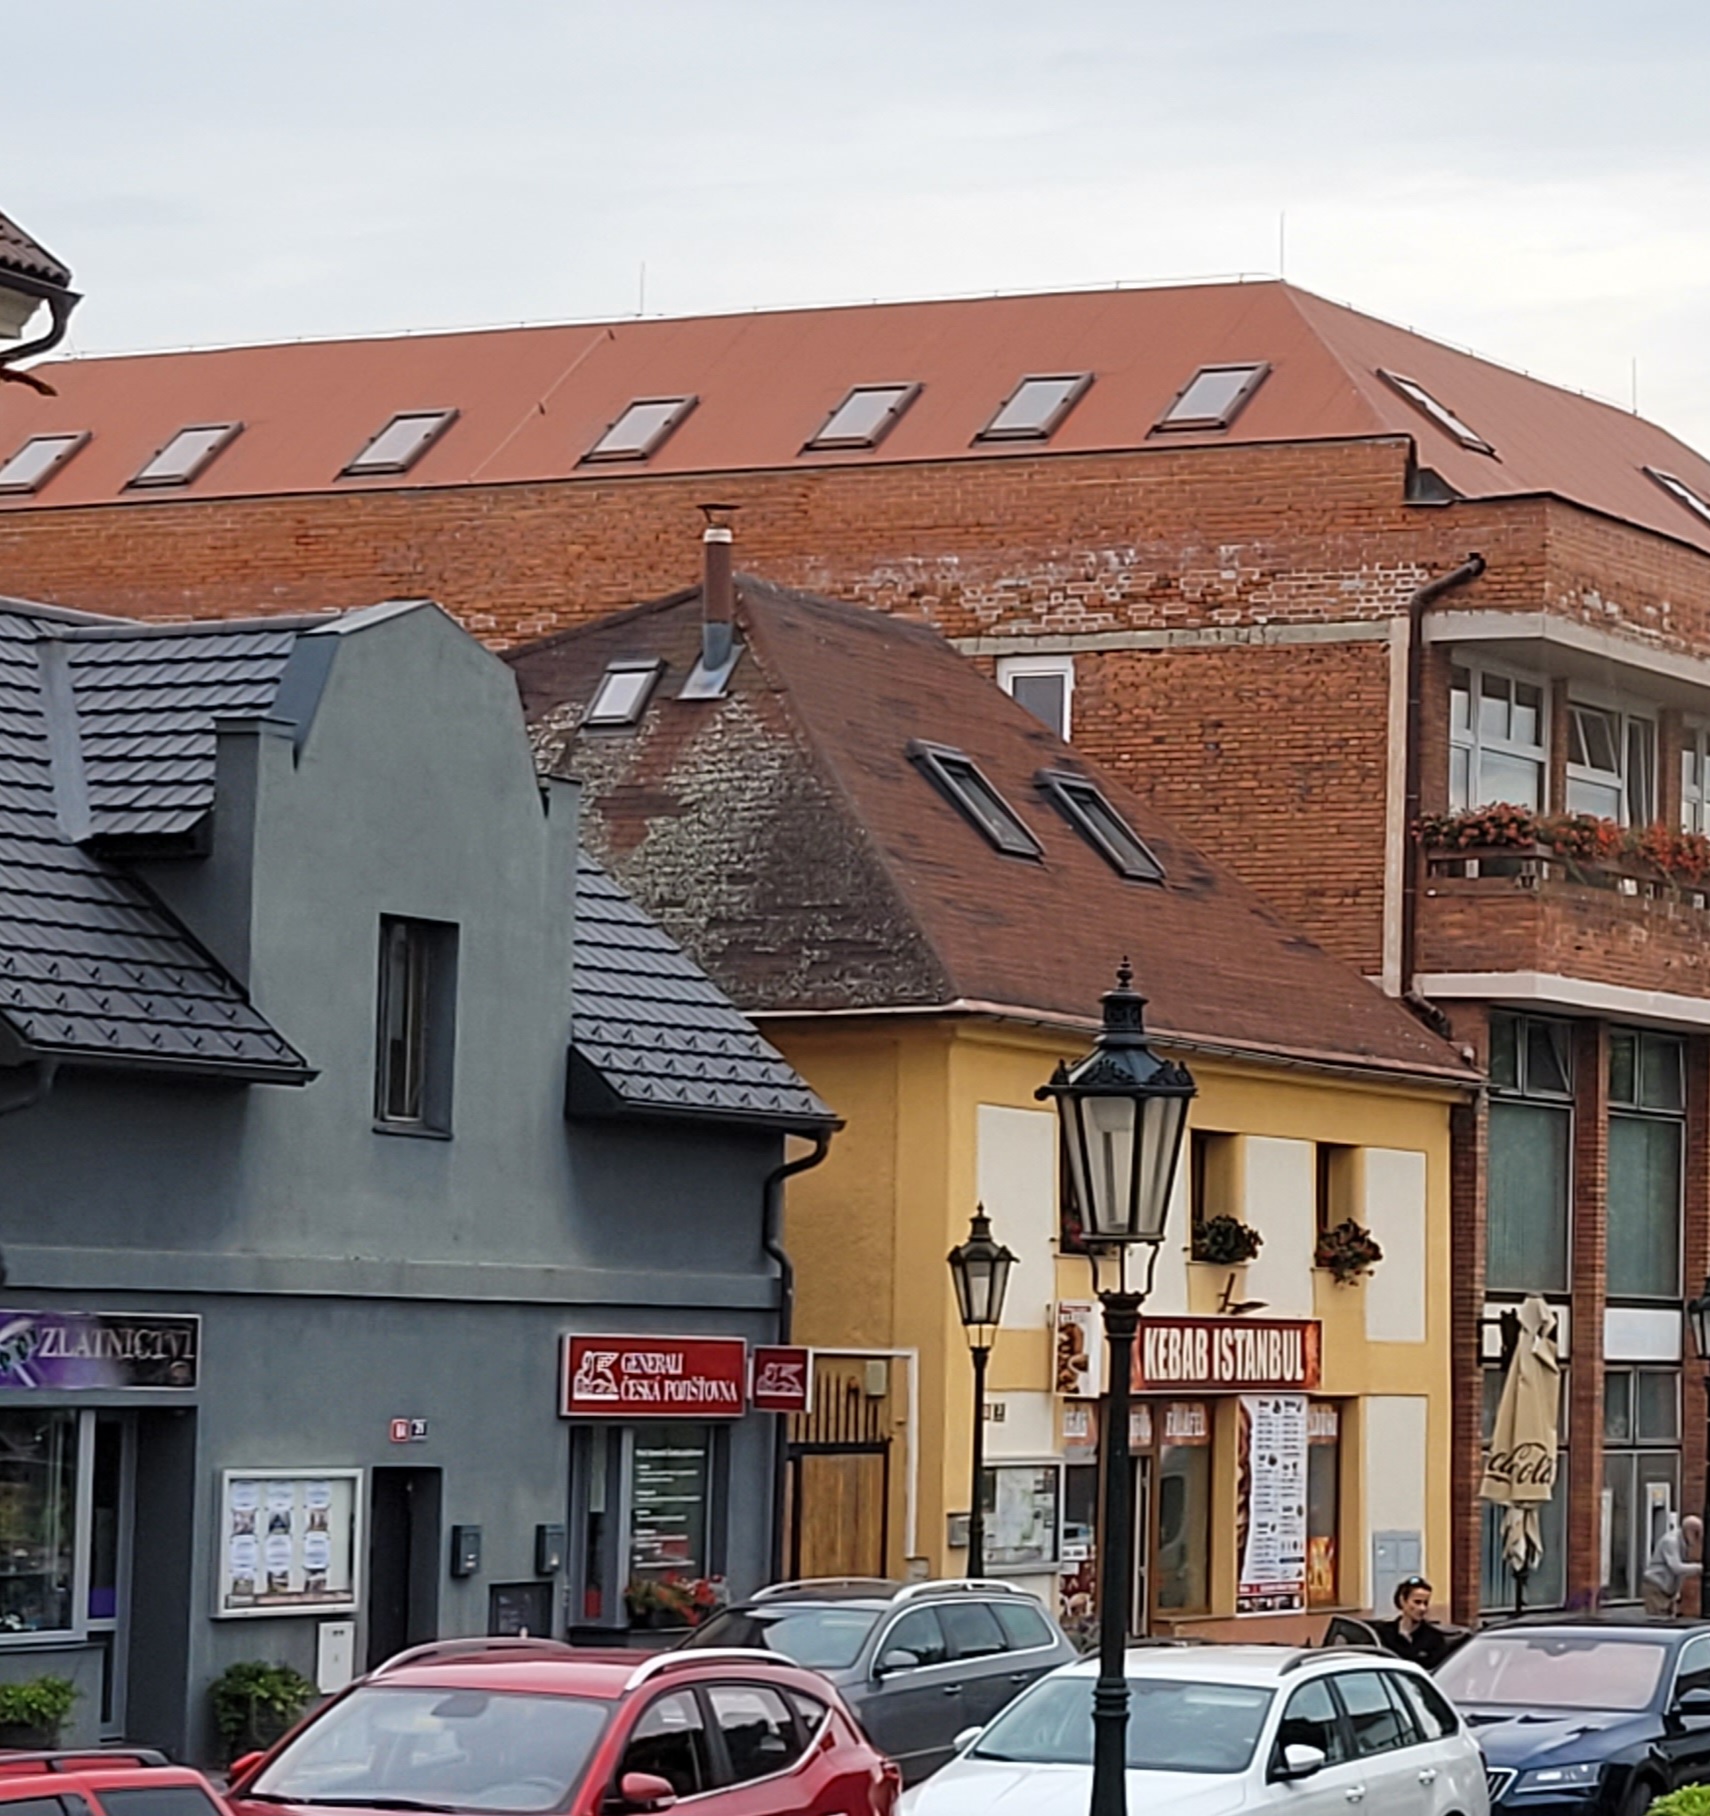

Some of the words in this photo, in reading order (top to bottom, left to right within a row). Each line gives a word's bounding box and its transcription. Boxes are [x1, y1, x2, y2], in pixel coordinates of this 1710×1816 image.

[620, 1352, 684, 1375] GENERALI
[1143, 1327, 1209, 1381] KEBAB
[1212, 1327, 1305, 1382] ISTANBUL
[620, 1375, 662, 1402] ČESKÁ
